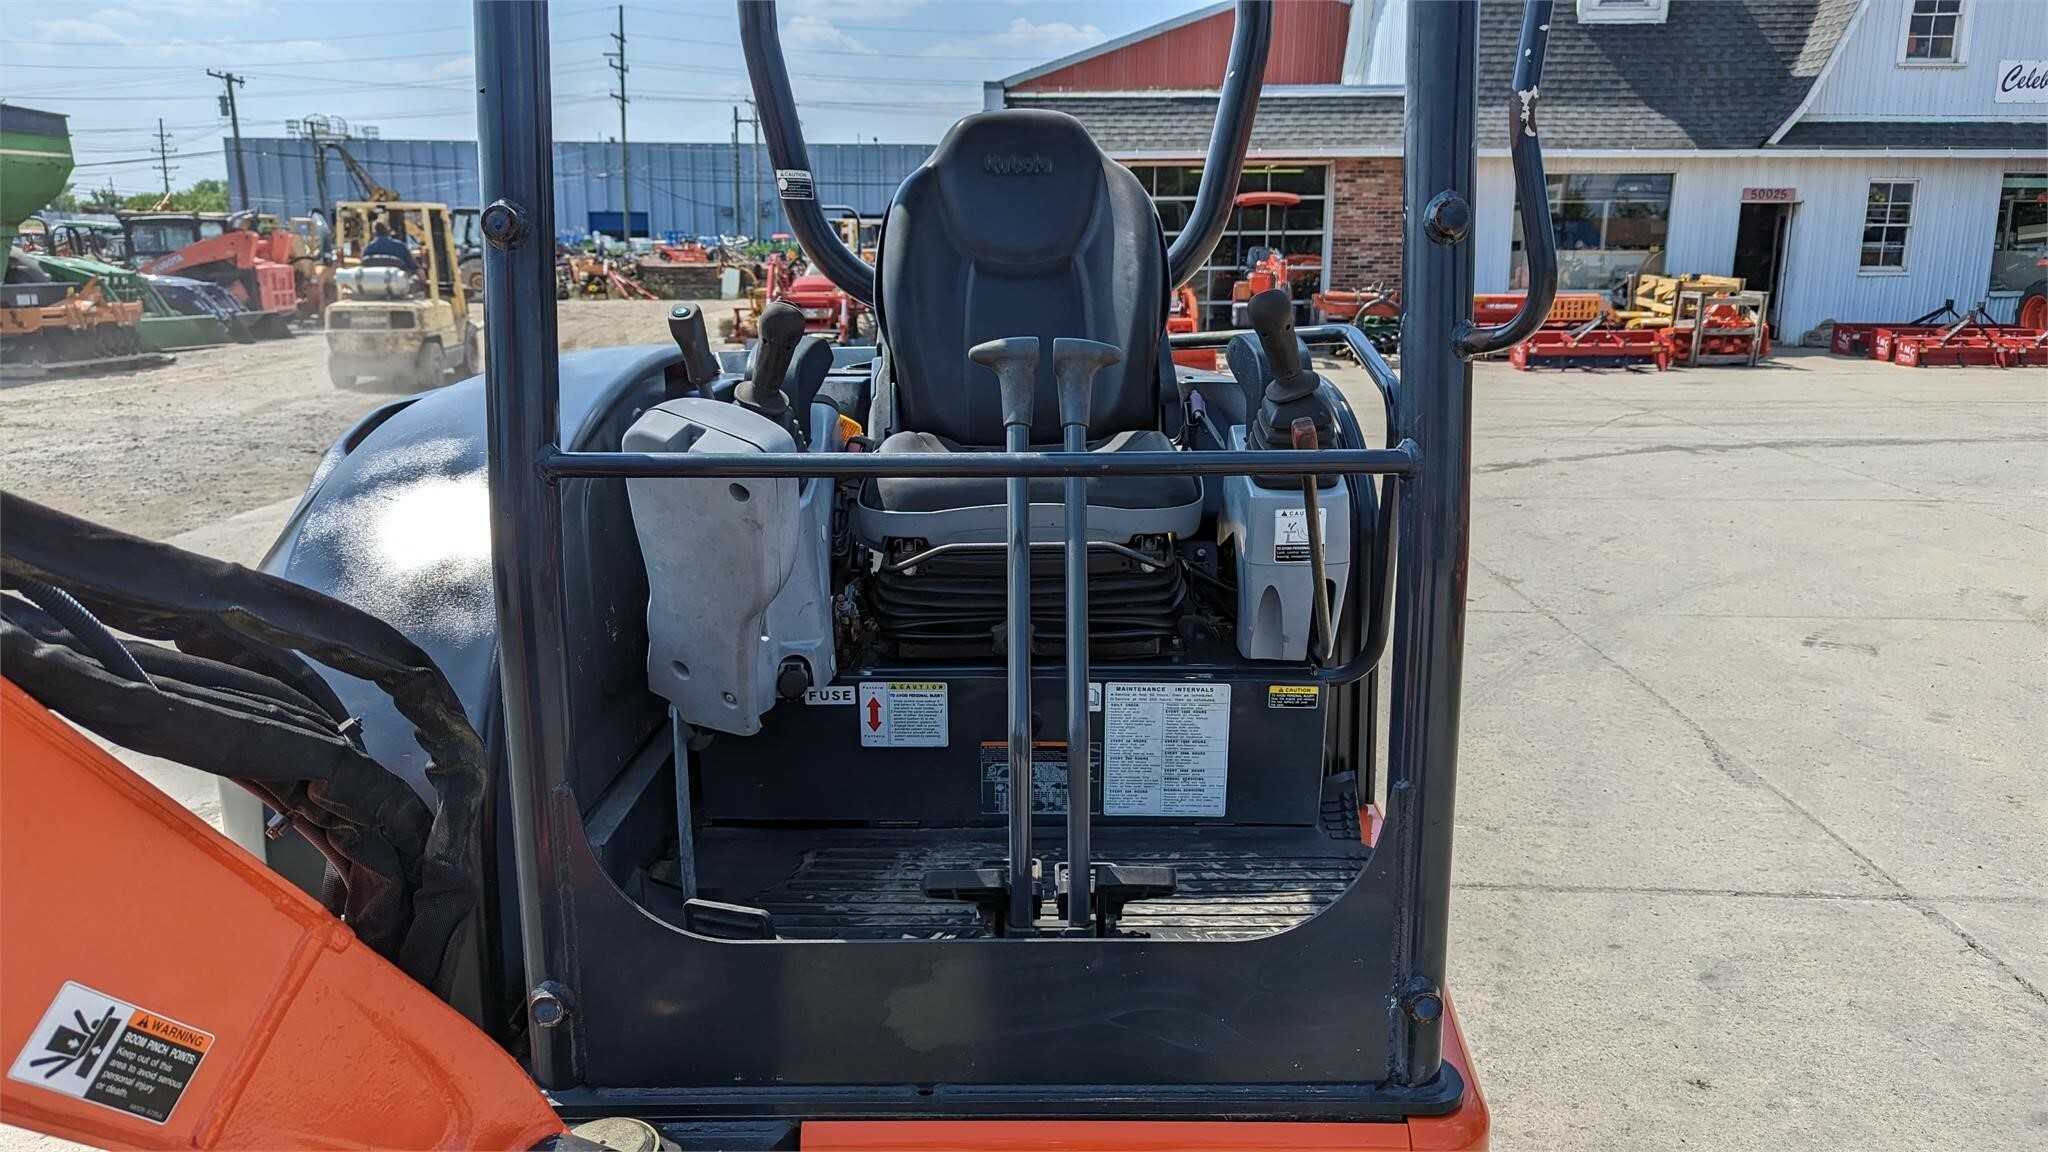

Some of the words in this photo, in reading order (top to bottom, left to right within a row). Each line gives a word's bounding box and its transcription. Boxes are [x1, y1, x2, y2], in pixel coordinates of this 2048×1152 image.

[1751, 189, 1788, 199] 50025
[1876, 335, 1890, 349] LMC
[1899, 342, 1916, 357] LMC
[809, 690, 851, 701] FUSE
[124, 1031, 148, 1048] BOOM
[146, 1039, 170, 1055] PINCH
[151, 1019, 204, 1047] WARNING
[116, 1046, 137, 1060] Keep
[137, 1055, 151, 1064] out
[150, 1058, 159, 1067] of
[159, 1061, 173, 1072] this
[101, 1071, 136, 1085] personal
[135, 1081, 156, 1095] injury
[109, 1059, 128, 1070] area
[128, 1064, 137, 1073] to
[137, 1068, 158, 1080] avoid
[157, 1075, 183, 1089] serious
